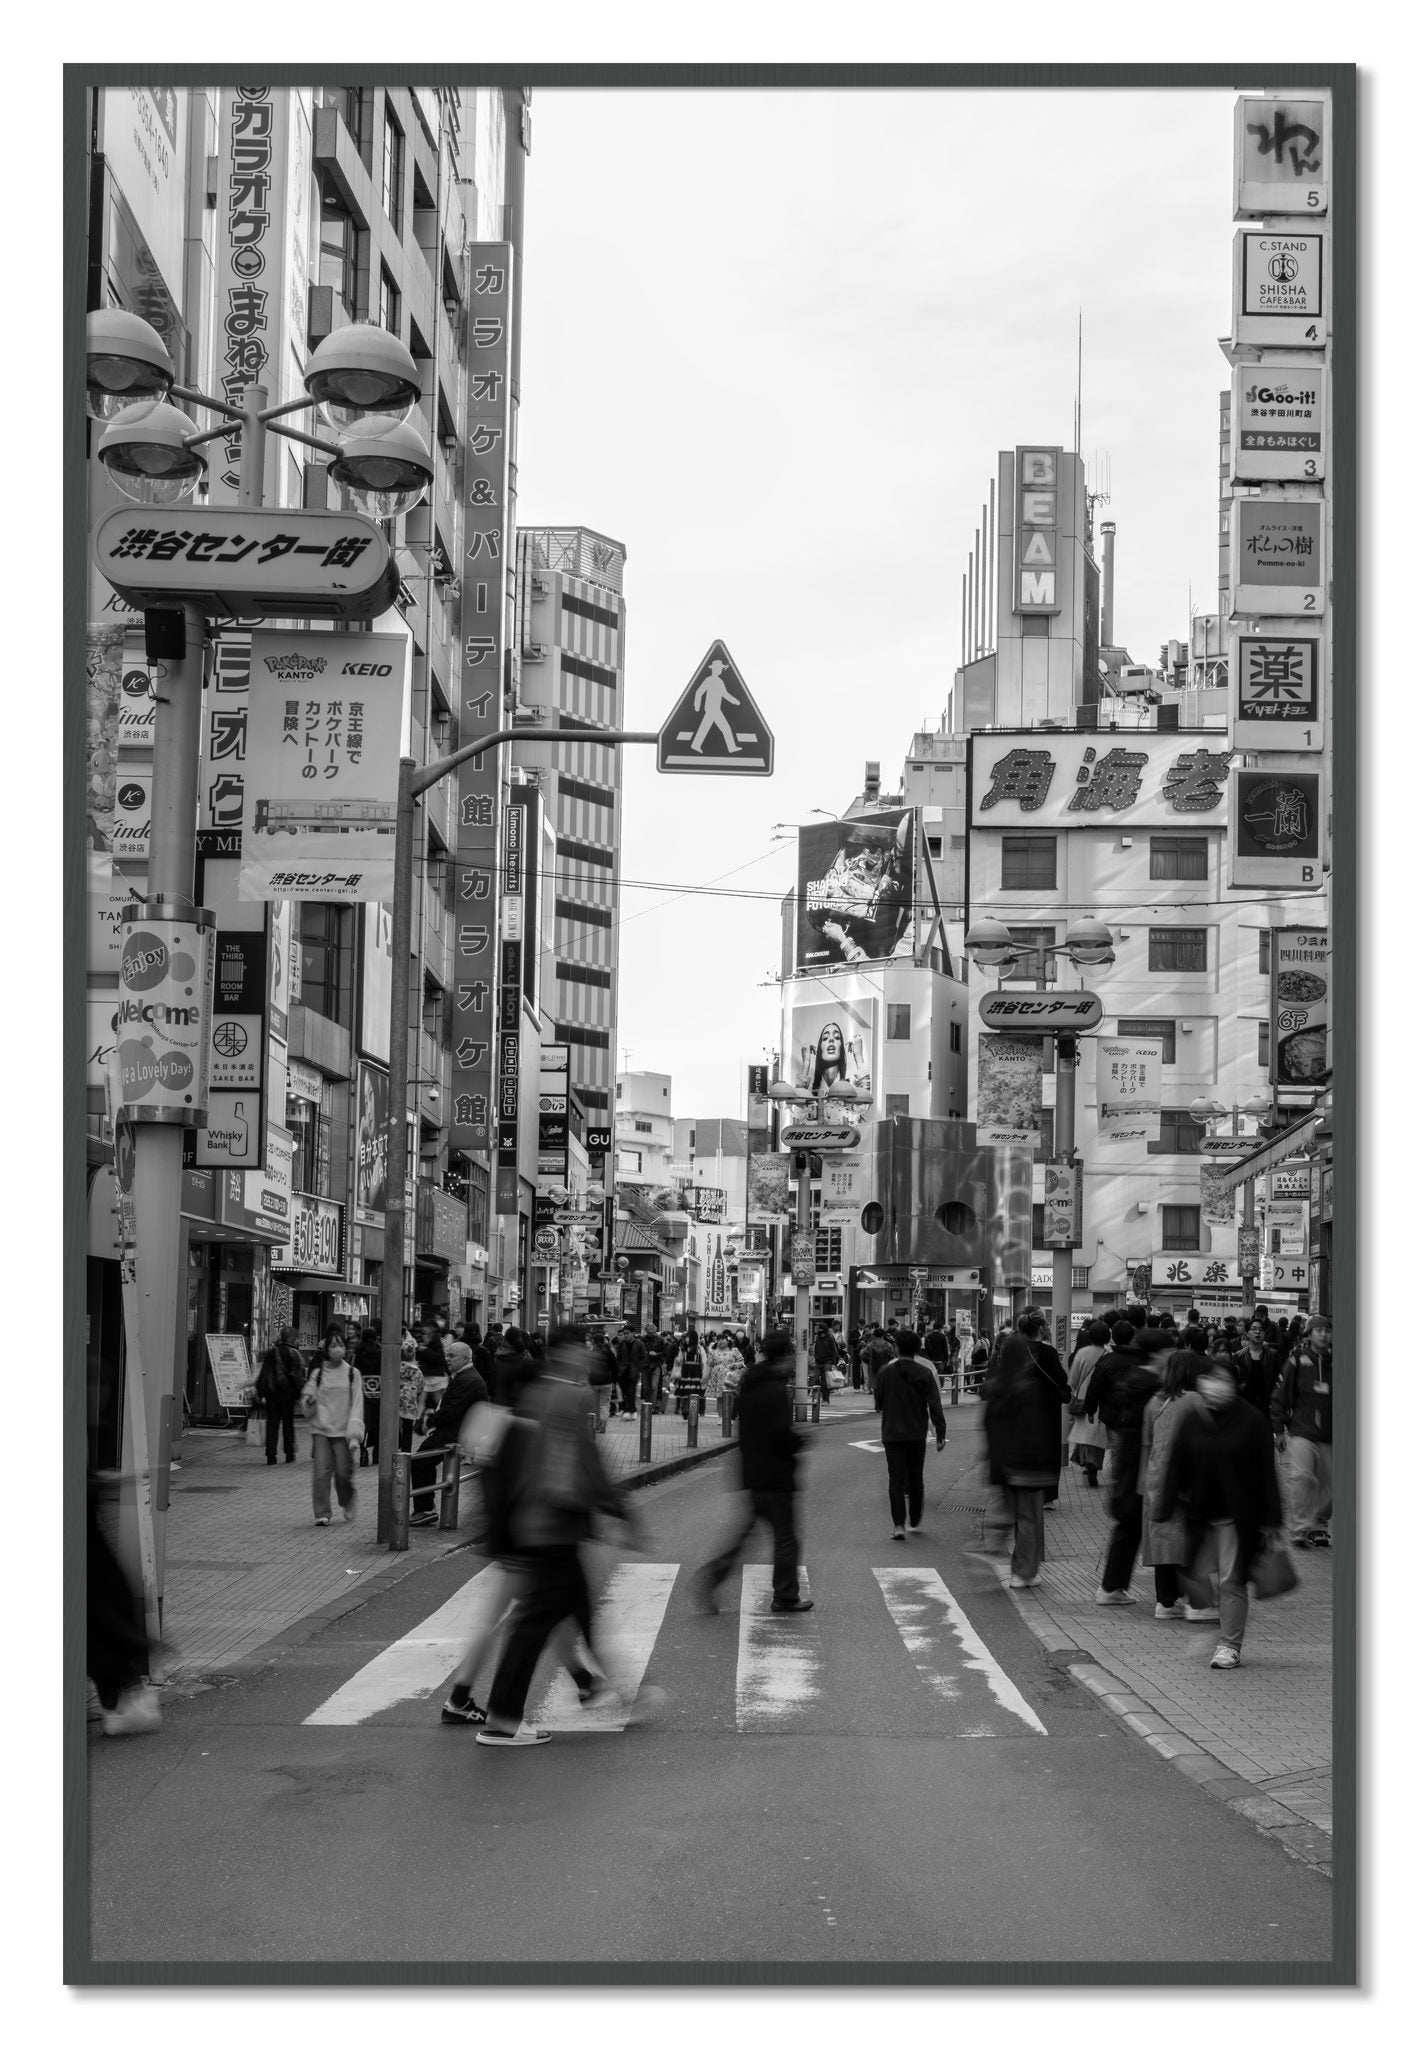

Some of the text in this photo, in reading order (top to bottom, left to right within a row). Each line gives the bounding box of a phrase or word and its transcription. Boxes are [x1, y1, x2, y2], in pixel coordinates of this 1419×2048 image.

[229, 101, 273, 247] カラオケ
[1307, 190, 1319, 208] 5
[1259, 241, 1307, 251] C.STAND
[1260, 284, 1306, 295] SHISHA
[1259, 296, 1306, 305] CAFE&BAR
[1258, 387, 1316, 404] Goo-it!
[1251, 408, 1312, 418] 渋谷宇田川町店
[1245, 434, 1317, 447] 全身もみほぐし
[1304, 459, 1317, 477] 3
[1021, 453, 1055, 605] BEAM
[109, 527, 373, 568] 渋谷センター街
[1257, 559, 1305, 567] Pomme-no-ki
[1303, 594, 1316, 610] 2
[277, 671, 315, 679] KANTO
[341, 662, 392, 677] KEIO
[1250, 645, 1303, 699] 薬
[283, 701, 299, 746] 冒険へ
[123, 729, 149, 738] 渋谷店
[302, 701, 321, 779] カントーの
[324, 701, 343, 779] ポケパーク
[346, 702, 365, 764] 京王線で
[1303, 730, 1312, 746] 1
[980, 747, 1231, 812] 角海老
[119, 843, 145, 853] 渋谷店
[508, 810, 518, 889] kimono hearts
[269, 872, 364, 887] 渋谷センター街
[1302, 865, 1314, 882] B
[1279, 948, 1327, 962] 四川料理
[123, 945, 165, 983] Enjoy
[454, 869, 491, 1126] カラオケ館
[119, 998, 200, 1026] Welcome
[986, 1000, 1095, 1015] 渋谷センター街
[1278, 1010, 1308, 1031] 6F
[149, 1022, 169, 1042] Shibuya
[137, 1060, 168, 1080] Lovely
[171, 1063, 191, 1077] Day!
[208, 1130, 243, 1143] Whisky
[588, 1134, 610, 1145] GU
[785, 1130, 850, 1141] 渋谷センター街
[207, 1140, 229, 1151] Bank
[1204, 1141, 1264, 1150] 渋谷センター街
[713, 1258, 724, 1303] BEER
[710, 1305, 724, 1313] HALL
